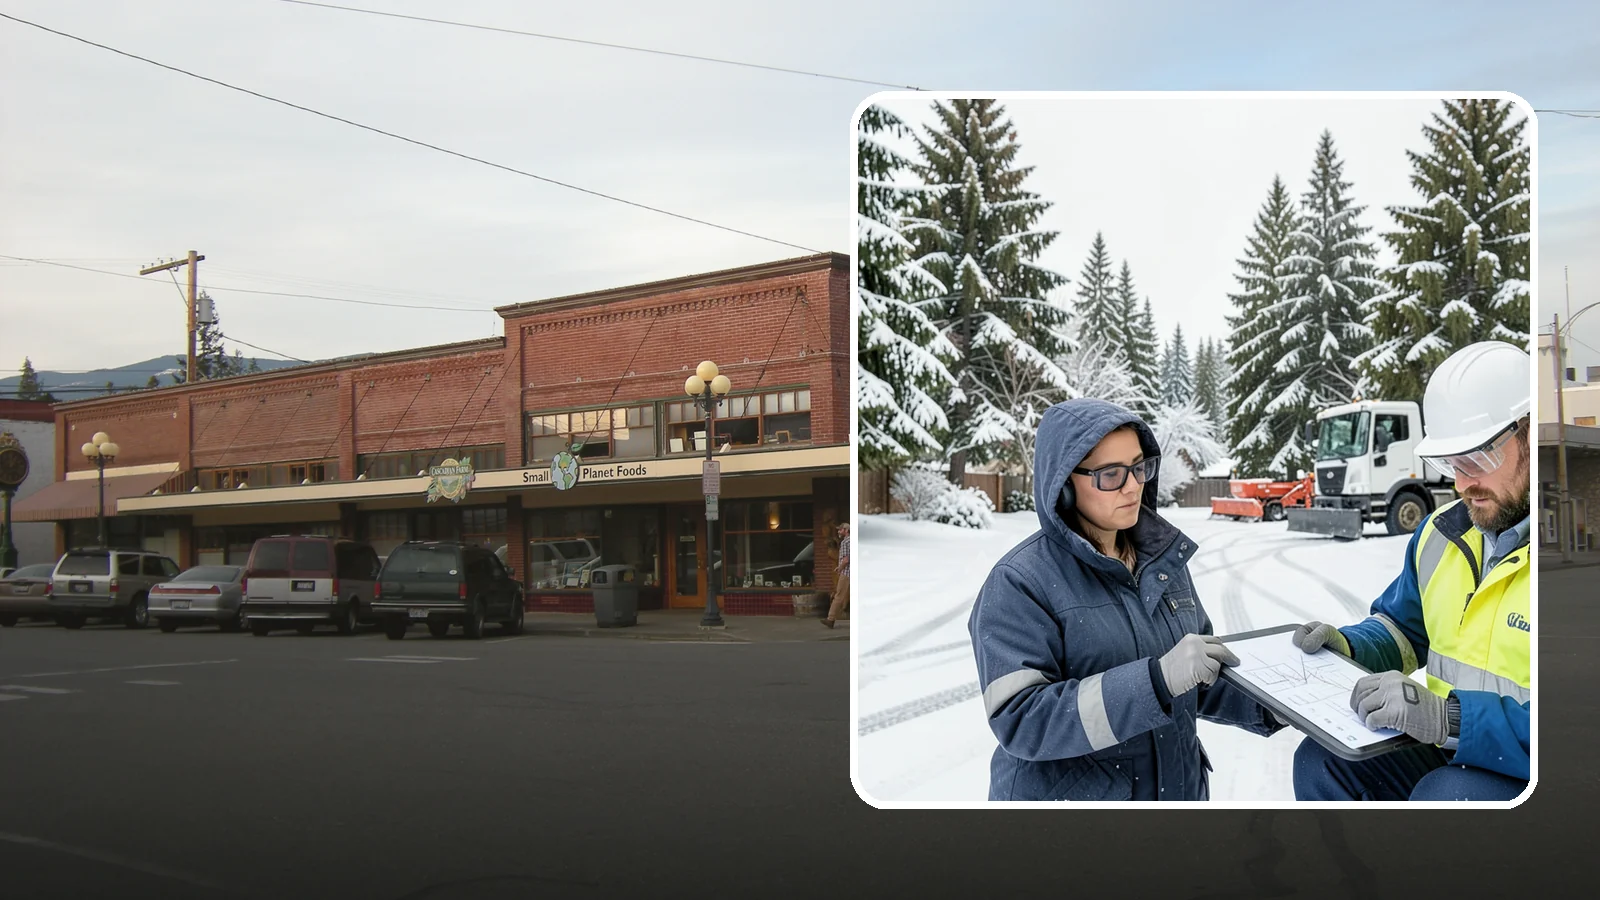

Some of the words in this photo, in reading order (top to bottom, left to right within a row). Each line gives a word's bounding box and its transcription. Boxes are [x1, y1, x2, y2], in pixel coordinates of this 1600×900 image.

[431, 466, 456, 476] CASCADIAN
[523, 471, 549, 483] Small
[583, 467, 614, 479] Planet
[617, 464, 647, 477] Foods
